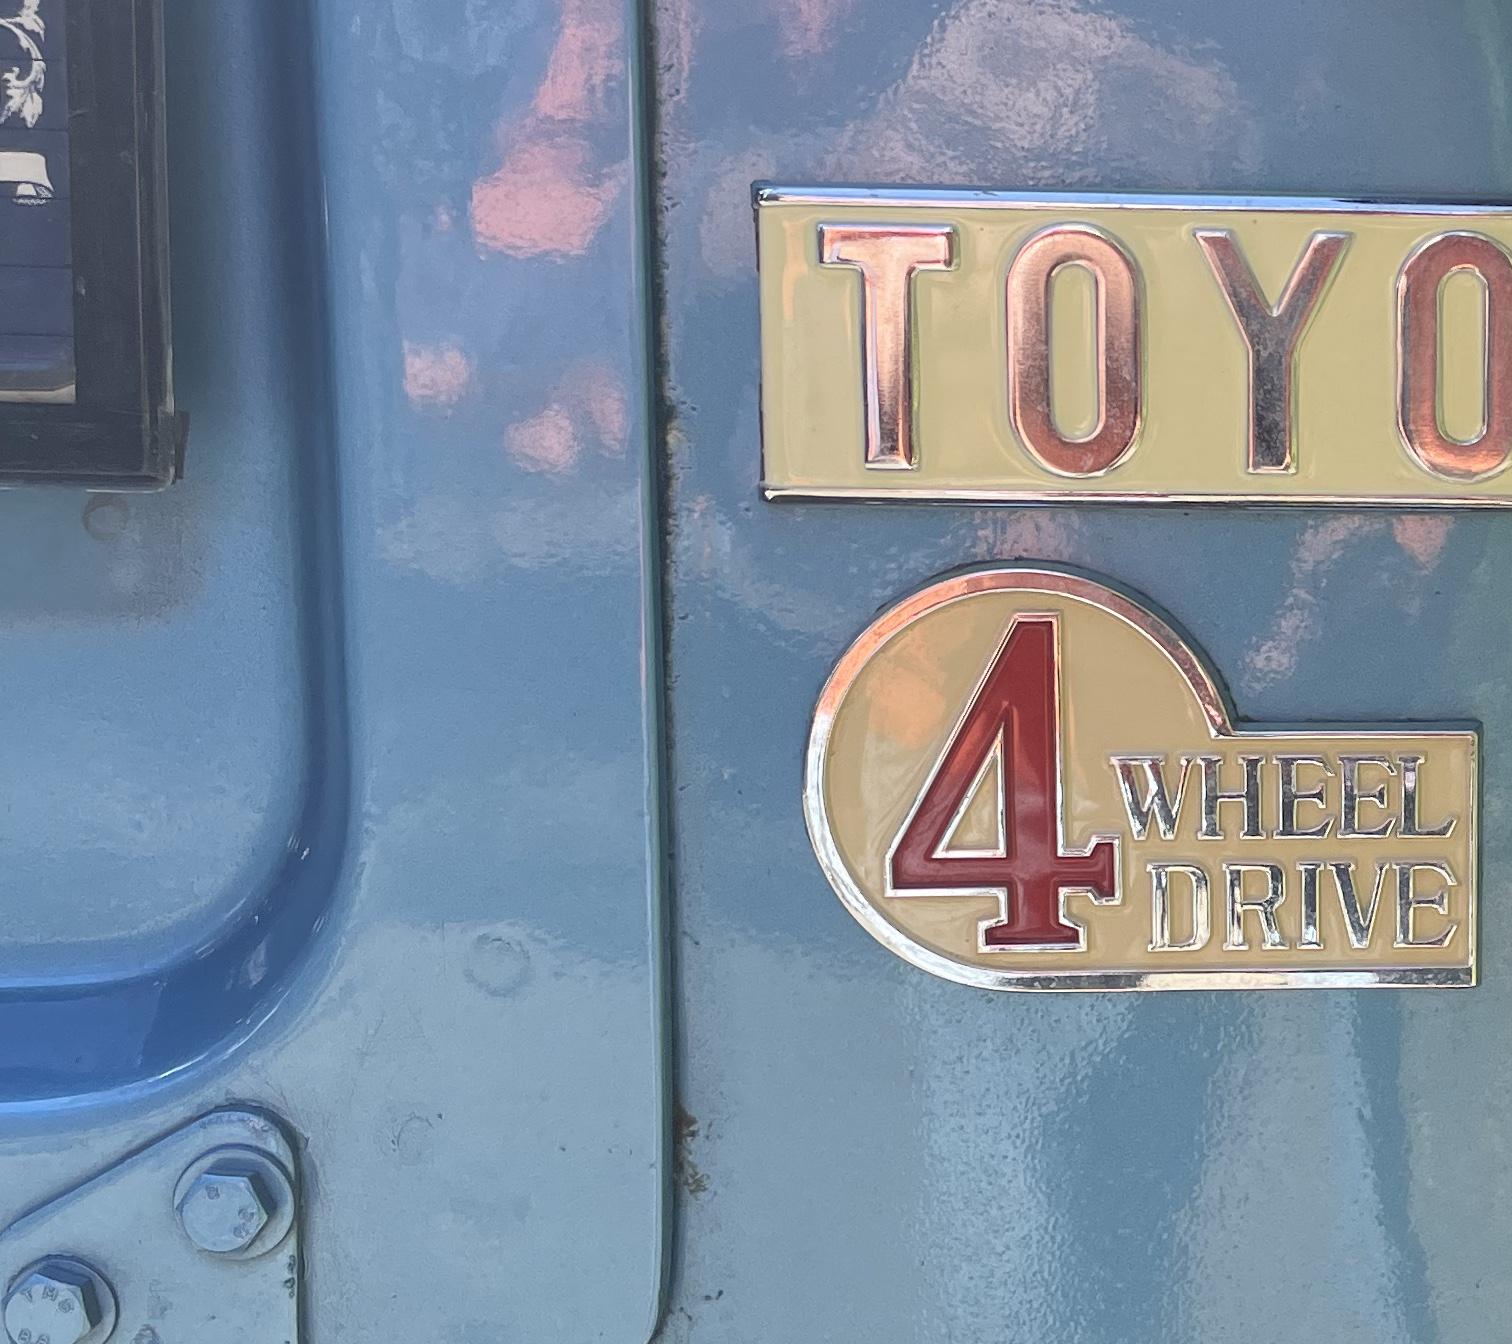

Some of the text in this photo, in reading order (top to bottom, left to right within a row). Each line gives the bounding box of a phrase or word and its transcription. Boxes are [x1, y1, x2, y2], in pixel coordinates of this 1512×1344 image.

[888, 613, 1456, 952] 4 WHEEL
[1147, 859, 1458, 954] DRIVE
